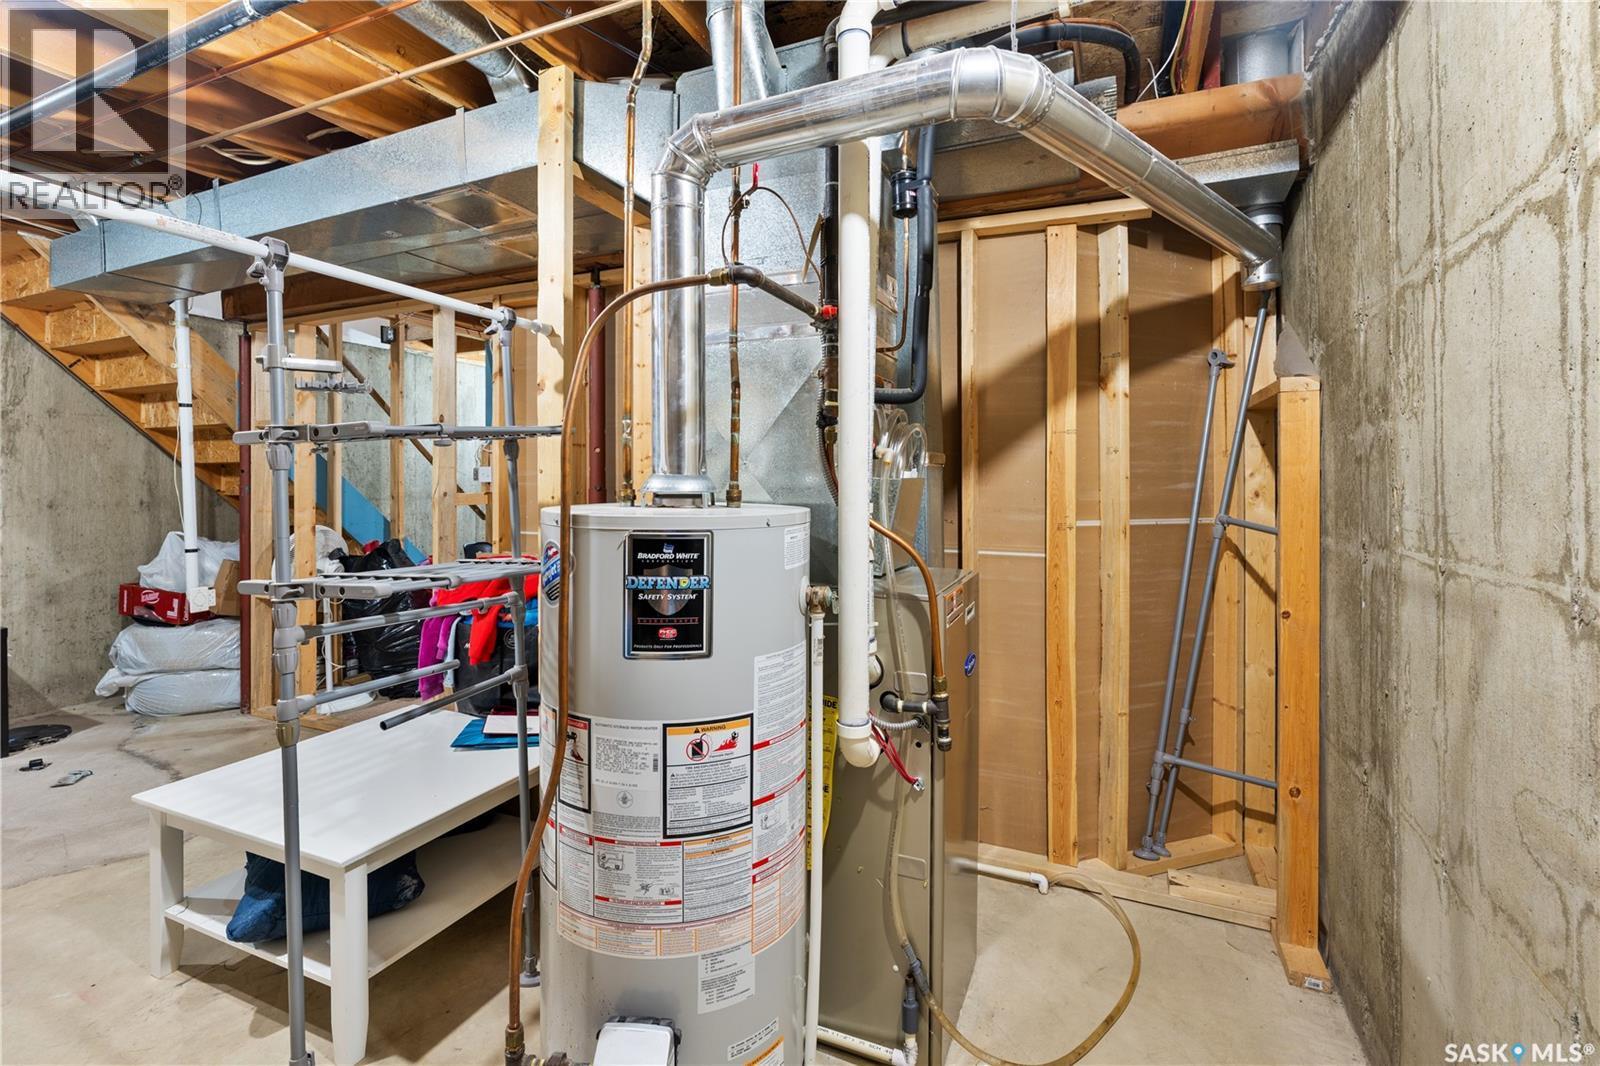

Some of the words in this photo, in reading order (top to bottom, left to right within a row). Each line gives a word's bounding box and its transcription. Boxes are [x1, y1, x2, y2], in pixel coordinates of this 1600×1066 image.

[637, 552, 675, 560] BRADFORD
[676, 552, 699, 560] WHITE
[626, 575, 710, 590] DEFENDER
[638, 593, 665, 601] SAFETY
[667, 593, 697, 601] SYSTEM
[701, 724, 726, 733] WARNING
